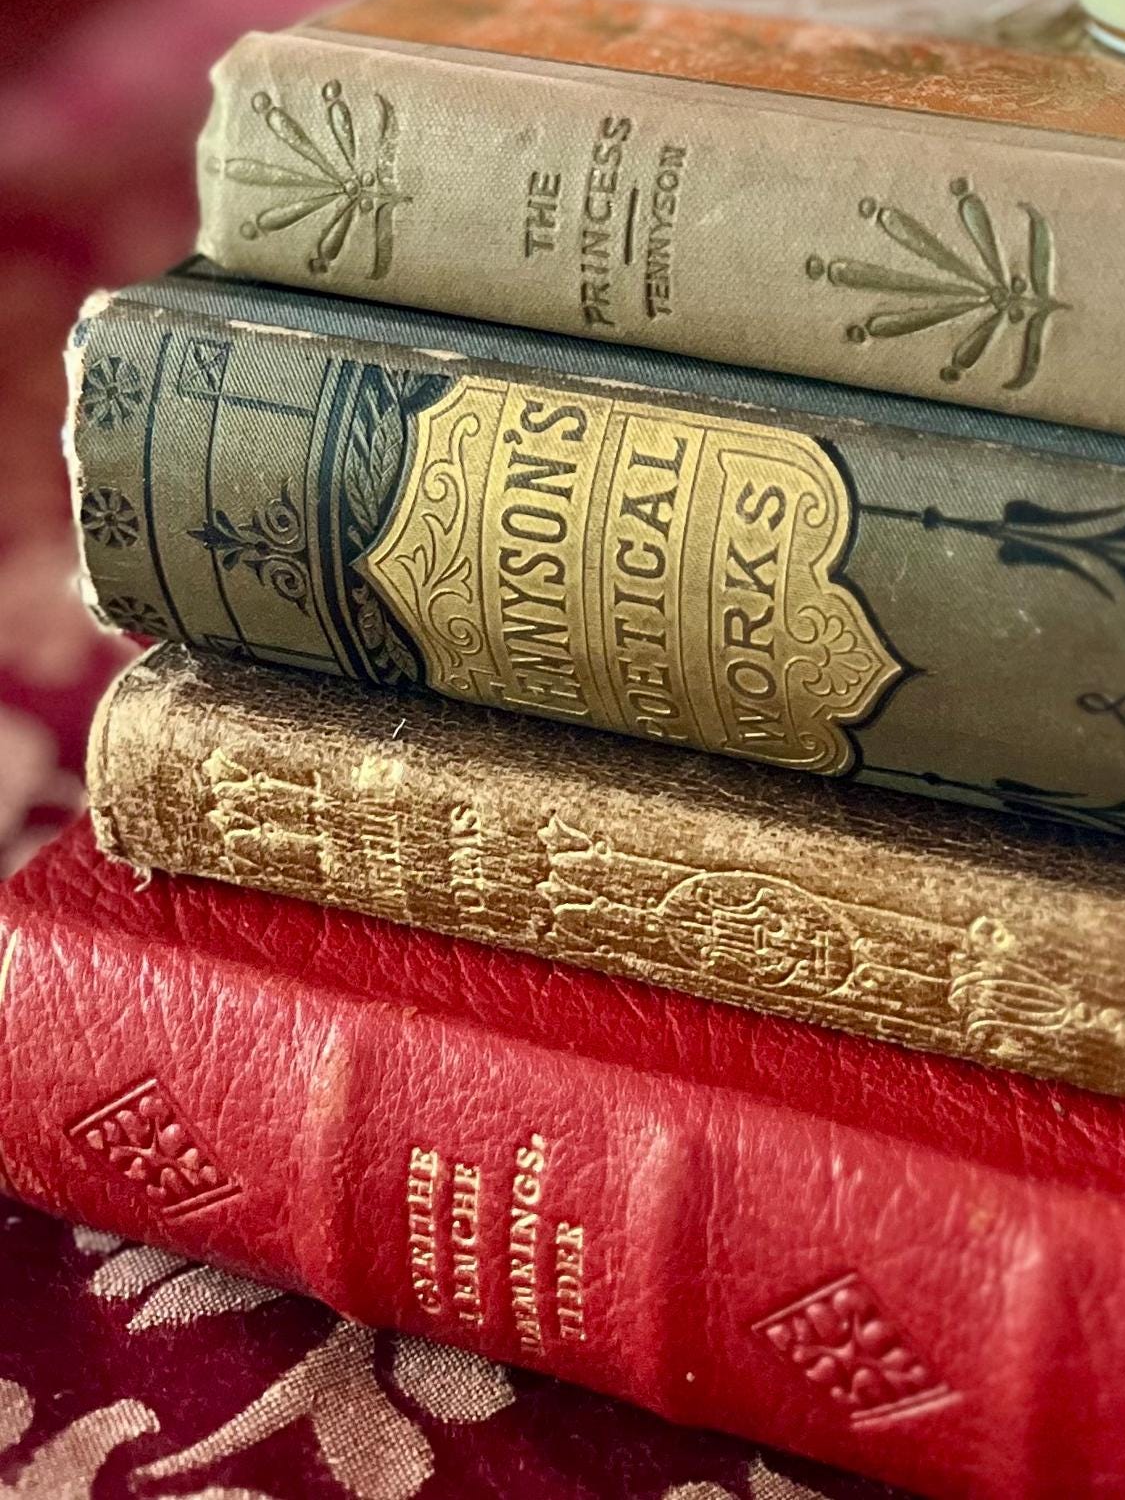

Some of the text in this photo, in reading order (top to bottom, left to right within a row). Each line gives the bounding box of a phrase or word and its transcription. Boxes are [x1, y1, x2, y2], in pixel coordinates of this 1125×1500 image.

[525, 170, 561, 258] THE
[581, 114, 632, 328] PRINCESS
[645, 144, 688, 319] TENNYSON
[491, 398, 589, 717] TENNYSON'S
[613, 435, 689, 740] POETICAL
[722, 479, 788, 744] WORKS
